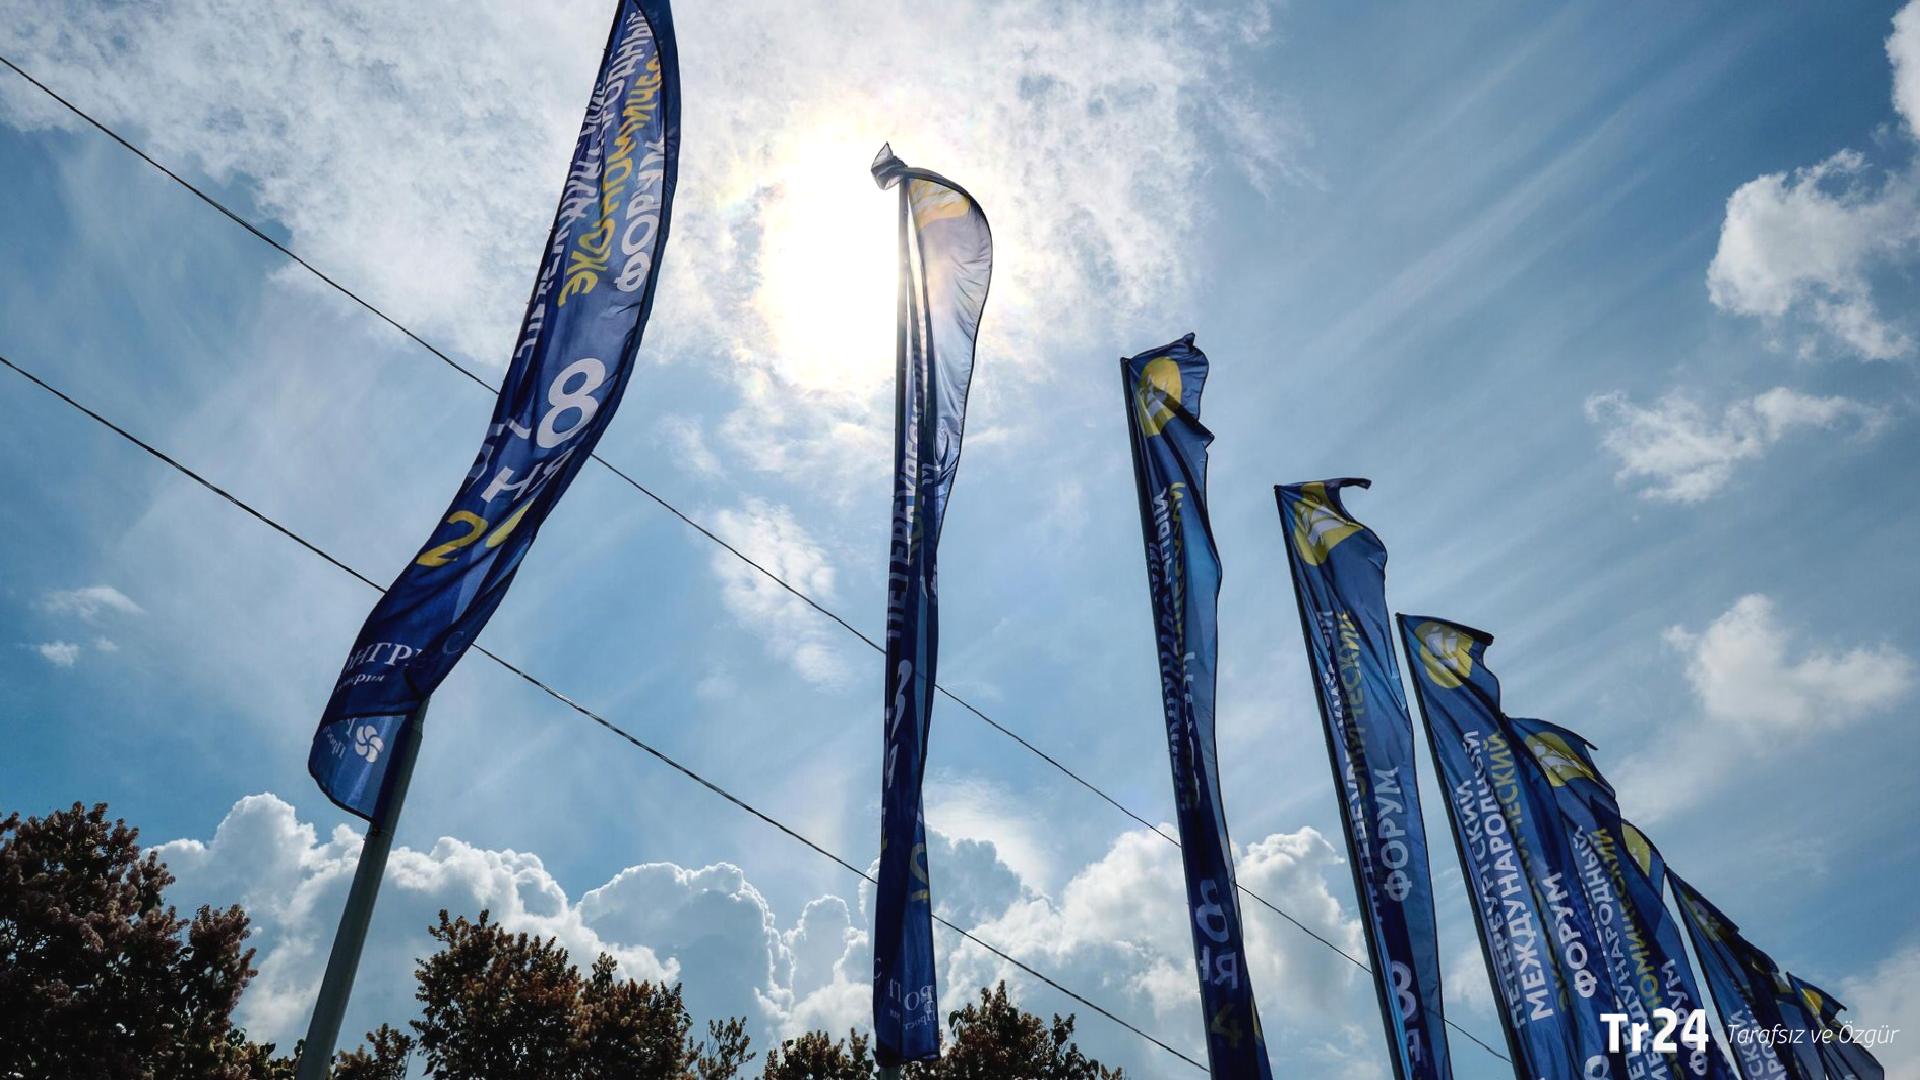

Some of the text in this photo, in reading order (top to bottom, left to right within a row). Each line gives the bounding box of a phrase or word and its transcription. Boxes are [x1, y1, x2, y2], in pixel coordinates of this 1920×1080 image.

[1375, 766, 1412, 901] ФОРУМ
[1463, 729, 1554, 1022] МЕЖДУНАРОДНЫЙ
[1540, 872, 1598, 999] ФОРУМ
